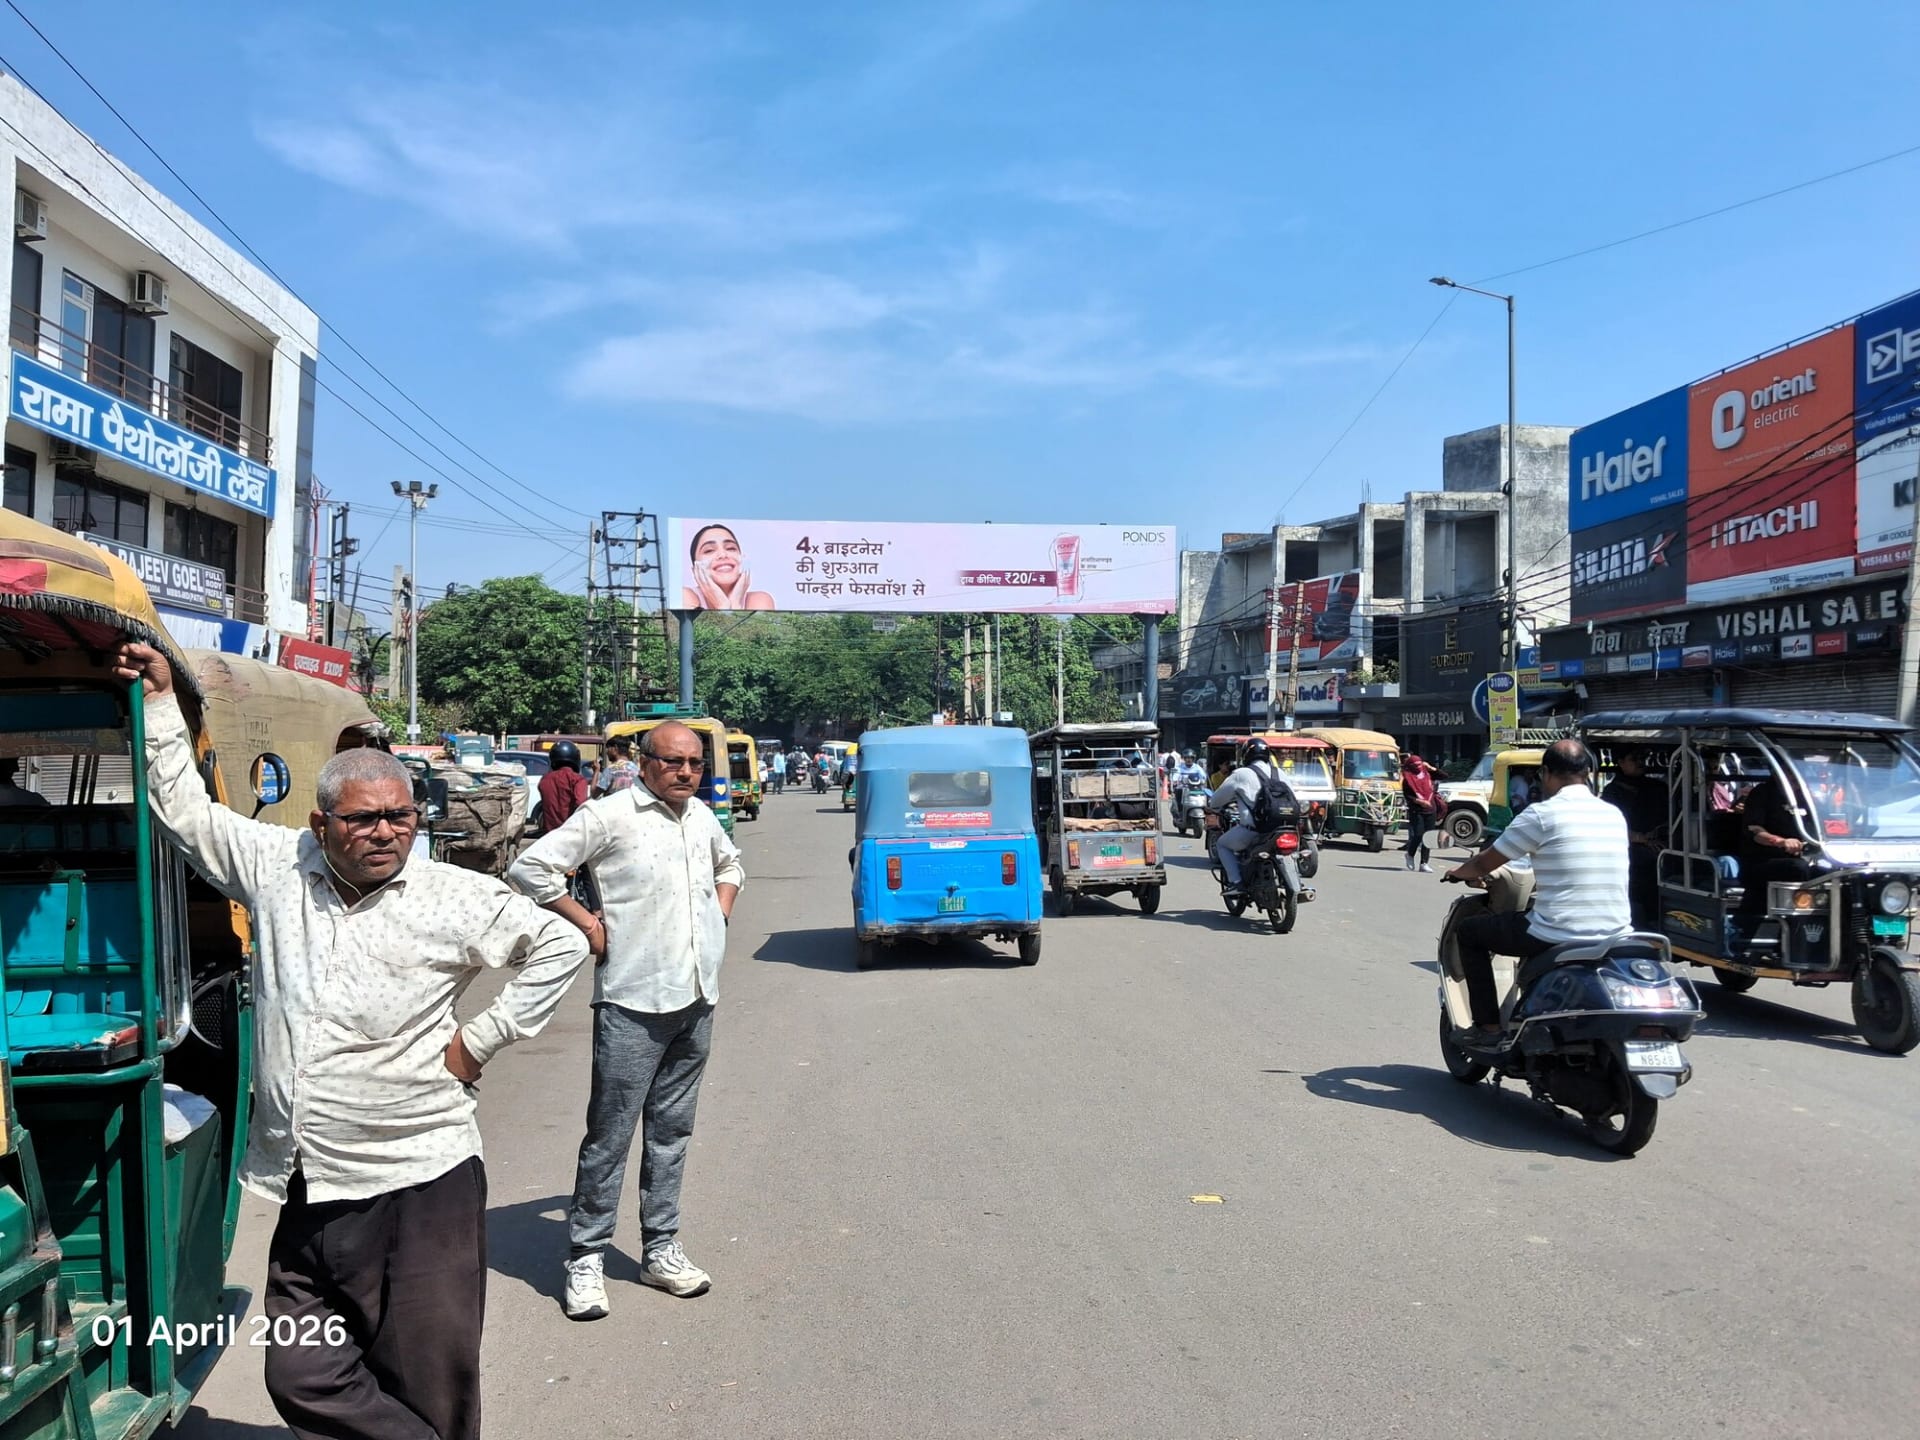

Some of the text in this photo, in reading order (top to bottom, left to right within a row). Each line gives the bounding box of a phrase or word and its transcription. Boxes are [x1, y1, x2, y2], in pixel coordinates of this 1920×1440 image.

[1751, 368, 1816, 410] orient
[1754, 404, 1800, 429] electric
[1864, 414, 1886, 431] Vishal
[19, 376, 266, 507] रामा पैथोलॉजी लैब
[1581, 436, 1667, 501] Haier
[1711, 500, 1817, 549] HITACHI
[796, 536, 884, 557] 4x ब्राइटनेस
[1122, 531, 1166, 543] POND'S
[795, 556, 879, 579] की शुरुआत
[1574, 538, 1646, 587] SUJATA
[1861, 554, 1893, 568] VISHAL
[172, 562, 204, 593] GOEL
[205, 570, 221, 581] FULL
[205, 580, 222, 591] BODY
[796, 577, 926, 599] पॉन्ड्स फेसवॉश से
[1717, 603, 1811, 638] VISHAL
[1715, 648, 1737, 659] Haier
[1402, 711, 1465, 726] ISHWAR FOAM
